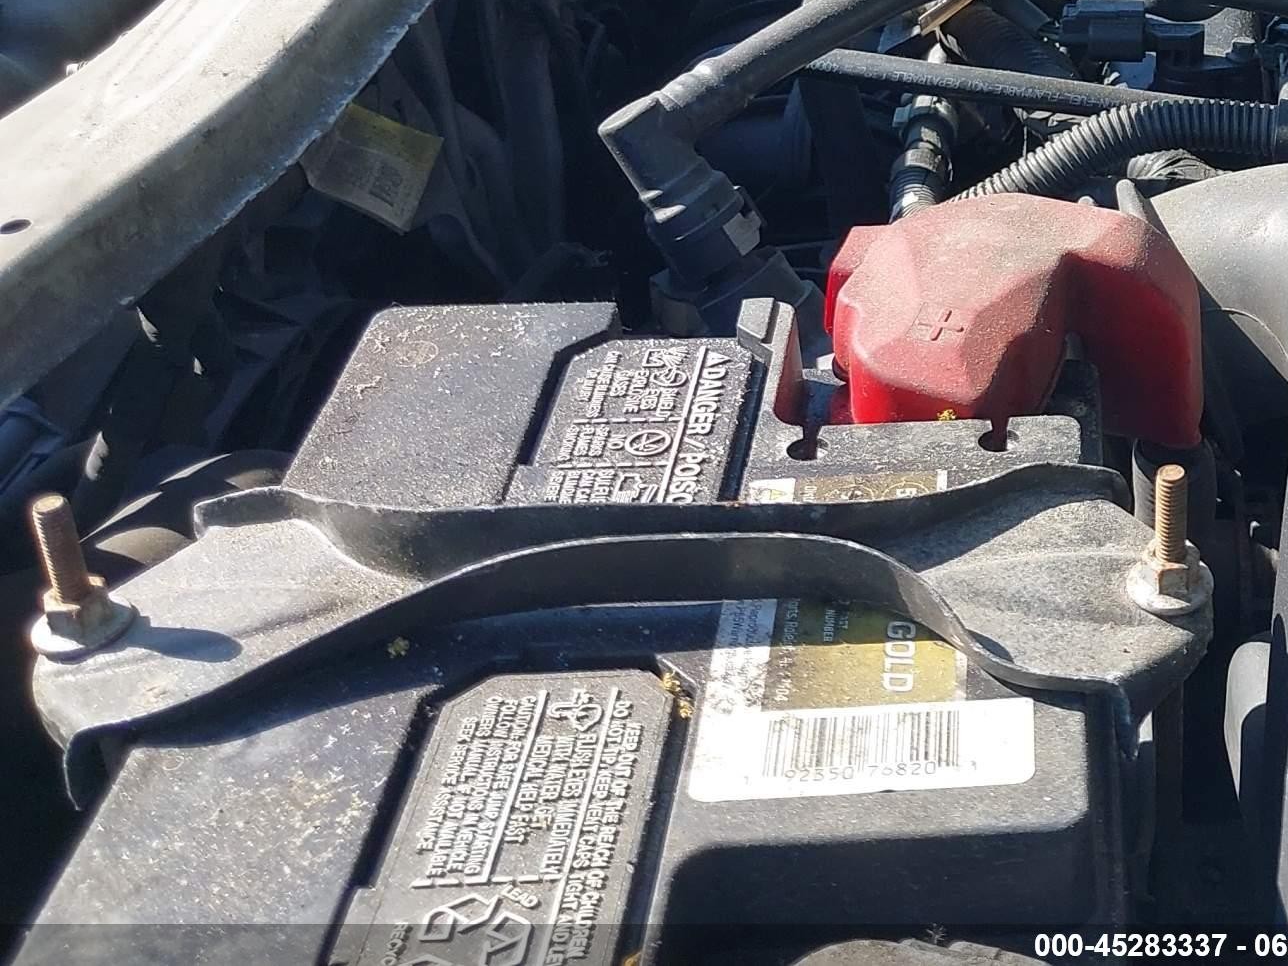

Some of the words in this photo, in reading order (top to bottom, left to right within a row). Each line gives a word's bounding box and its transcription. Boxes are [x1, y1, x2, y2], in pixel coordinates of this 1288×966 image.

[580, 378, 597, 402] INJURY
[608, 370, 630, 398] GASES
[623, 370, 650, 414] EXPLOSIVE
[586, 385, 608, 418] BLINDNESS
[640, 388, 660, 410] EYES
[654, 388, 679, 419] SHIELD
[686, 368, 728, 435] DANGER
[608, 434, 626, 451] NO
[823, 609, 837, 642] NUMBER
[881, 621, 916, 692] GOLD
[476, 696, 502, 737] OWNERS
[492, 700, 518, 738] FOLLOW
[510, 696, 536, 740] CAUTION:
[613, 700, 632, 718] DO
[457, 717, 478, 742] SEEK
[607, 720, 625, 744] NOT
[622, 723, 642, 751] KEEP
[502, 740, 522, 763] FOR
[523, 736, 554, 781] MEDICAL
[552, 735, 576, 761] WITH
[571, 734, 598, 767] FLUSH
[442, 745, 468, 786] SERVICE
[468, 740, 504, 811] INSTRUCTIONS
[492, 764, 515, 790] SAFE
[614, 753, 636, 779] OUT
[514, 783, 539, 810] HELP
[562, 770, 588, 798] EYES
[592, 769, 614, 798] KEEP
[610, 780, 630, 798] OF
[446, 797, 467, 819] NOT
[484, 791, 504, 819] JUMP
[530, 806, 554, 829] GET
[582, 802, 605, 833] VENT
[601, 798, 624, 824] THE
[462, 813, 480, 826] IN
[504, 814, 530, 843] FAST
[427, 822, 460, 878] AVAILABLE
[446, 827, 477, 872] VEHICLE
[464, 822, 496, 874] STARTING
[539, 800, 580, 874] IMMEDIATELY
[590, 826, 616, 867] REACH
[572, 836, 596, 868] CAPS
[561, 870, 587, 911] TIGHT
[585, 870, 605, 888] OF
[502, 883, 539, 907] LEAD
[551, 914, 576, 942] AND
